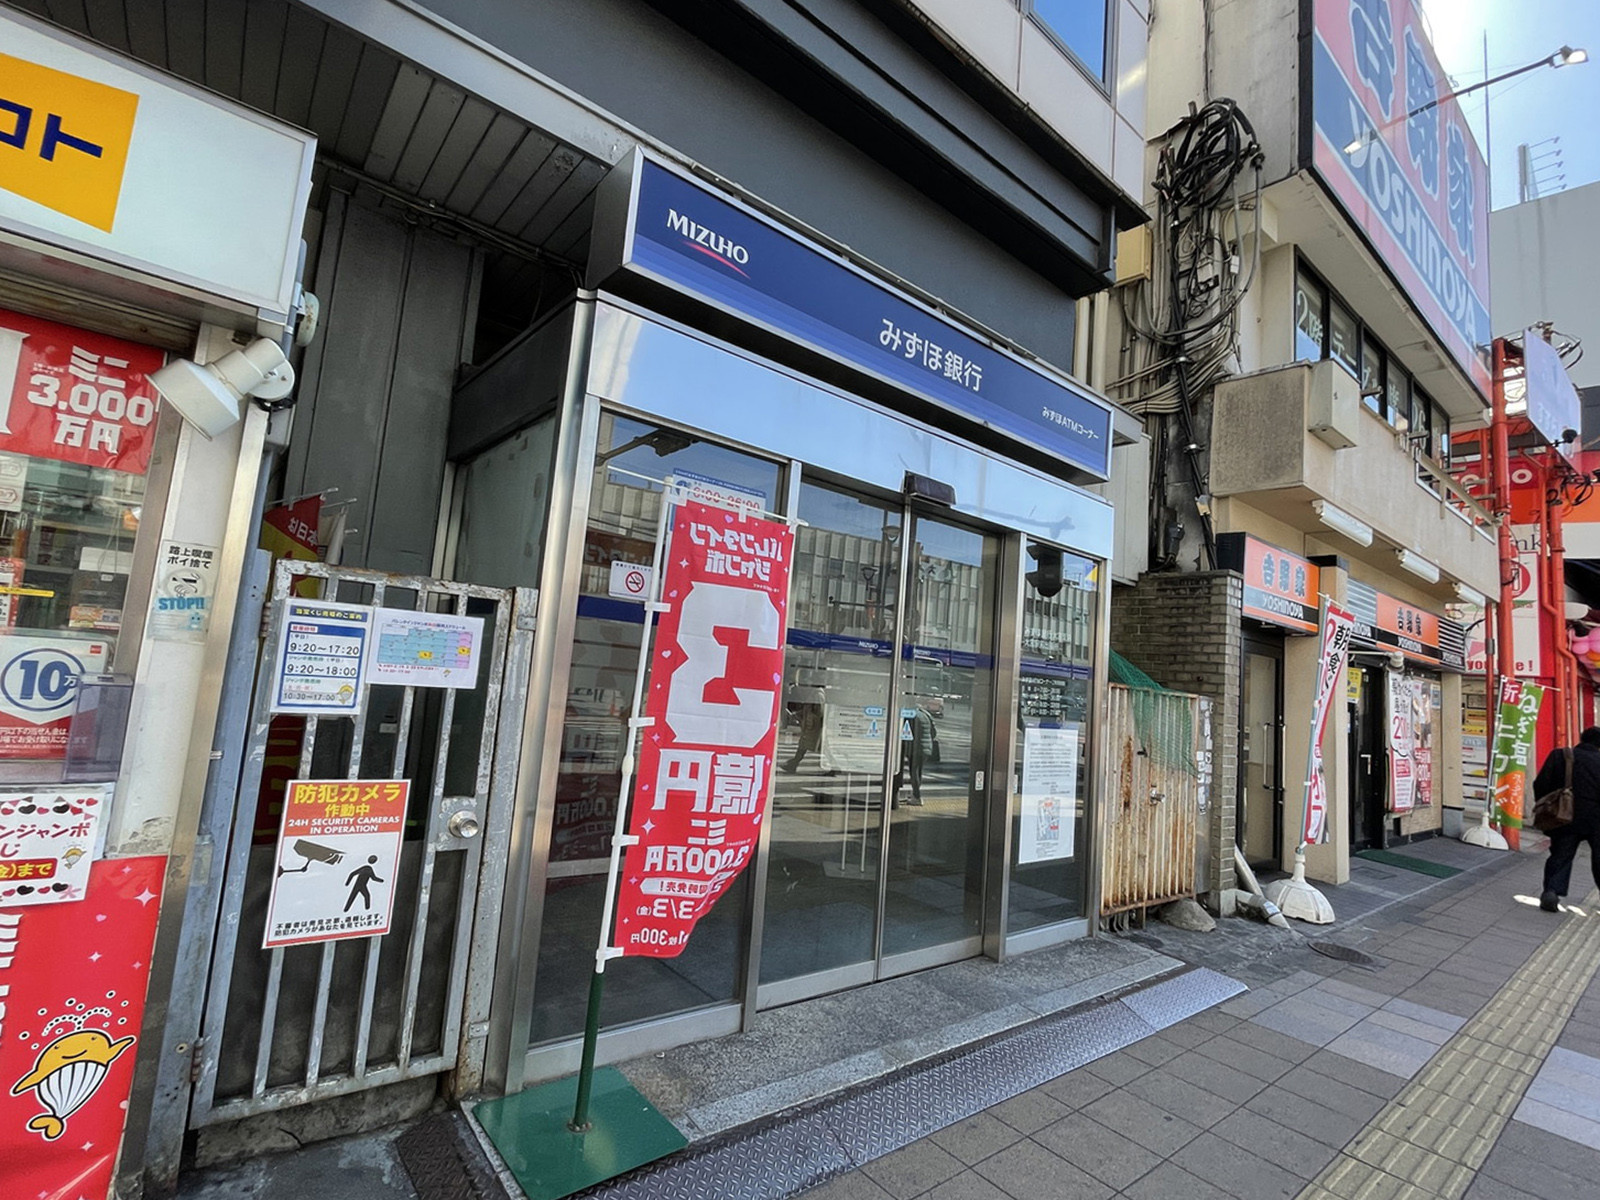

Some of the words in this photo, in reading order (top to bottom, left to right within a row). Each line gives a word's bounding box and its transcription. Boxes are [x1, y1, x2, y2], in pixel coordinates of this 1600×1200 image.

[667, 208, 750, 265] MIZUHO
[1348, 97, 1479, 350] YOSHINOYA
[69, 345, 130, 388] ミニ
[879, 318, 982, 391] みずほ銀行
[54, 413, 124, 454] 万円
[1041, 406, 1099, 440] みずほATMコーナー
[167, 556, 212, 569] ポイ捨て
[168, 545, 214, 560] 路上喫煙
[1262, 551, 1306, 598] 吉野家
[1261, 592, 1304, 621] YOSHINOYA
[293, 783, 401, 805] 防犯カメラ
[288, 818, 309, 827] 24H
[311, 817, 354, 827] SECURITY
[357, 815, 400, 824] CAMERAS
[324, 803, 371, 818] 作動中
[310, 826, 327, 834] IN
[328, 824, 379, 834] OPERATION
